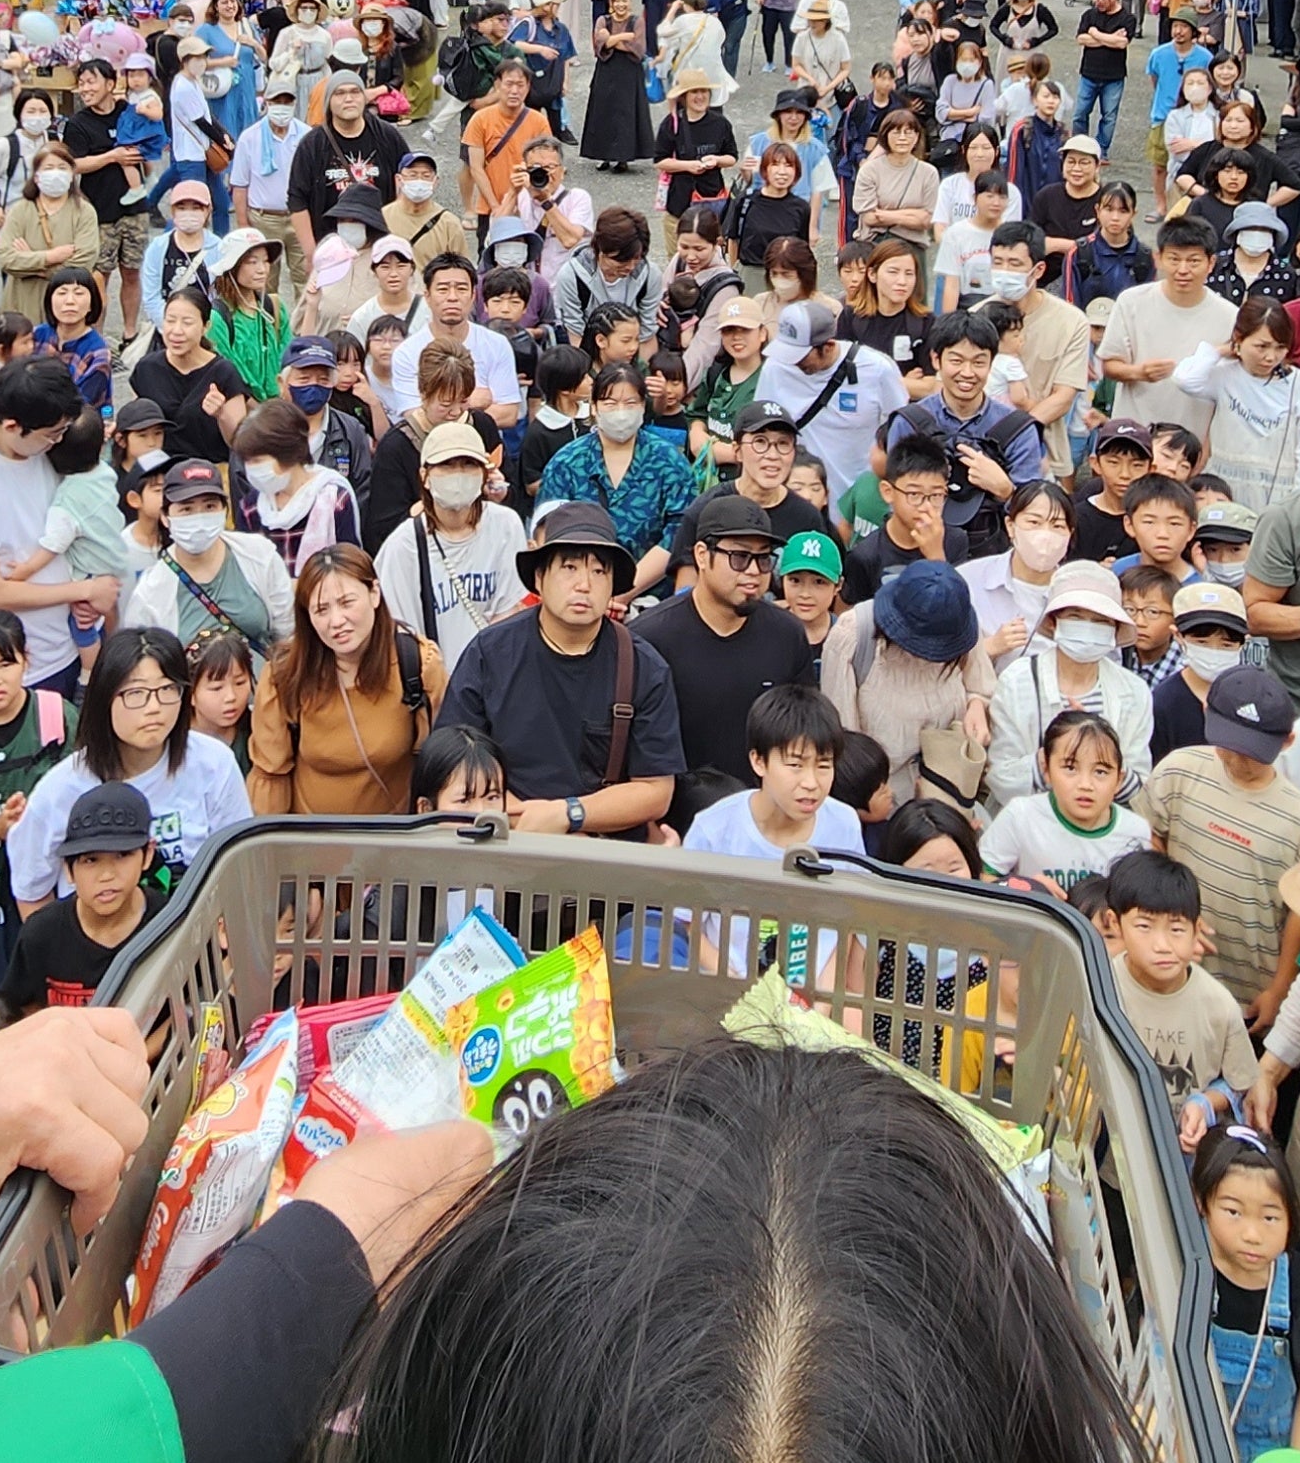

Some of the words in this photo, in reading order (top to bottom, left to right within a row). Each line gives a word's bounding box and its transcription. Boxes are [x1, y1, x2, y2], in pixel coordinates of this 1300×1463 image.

[801, 539, 821, 558] NY
[71, 803, 137, 831] adidas
[1208, 821, 1251, 847] CONVERSE
[505, 981, 581, 1041] ポテコ
[1144, 1026, 1187, 1045] TAKE
[298, 1122, 344, 1147] カルシウム
[140, 1202, 170, 1271] Calbee
